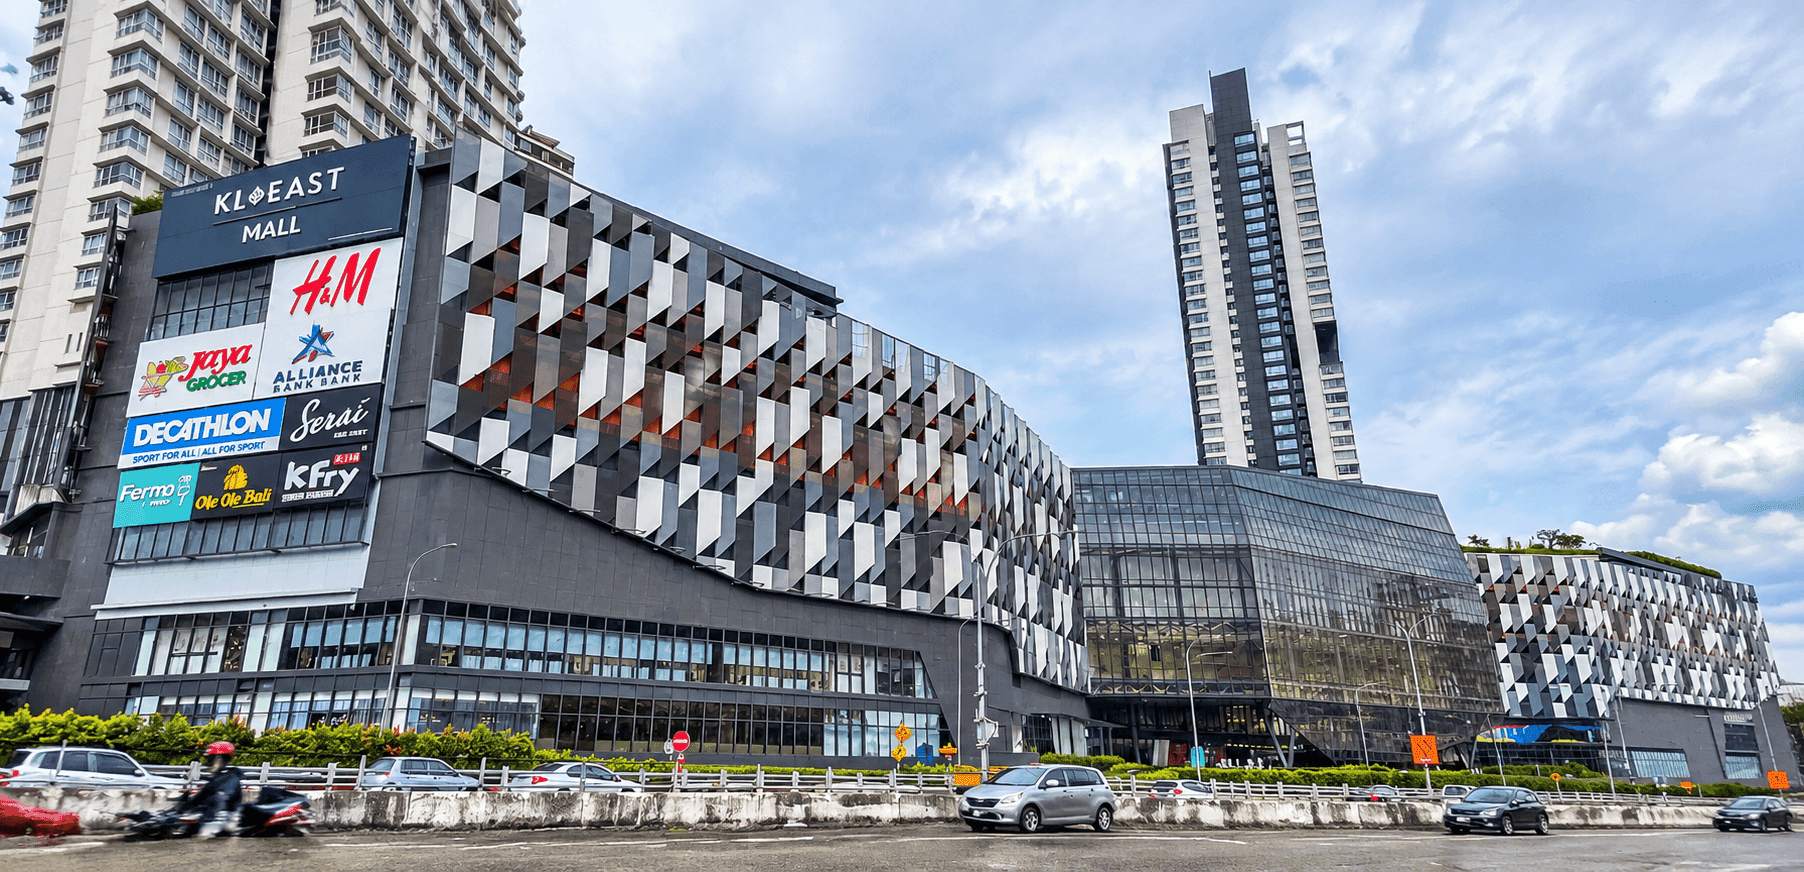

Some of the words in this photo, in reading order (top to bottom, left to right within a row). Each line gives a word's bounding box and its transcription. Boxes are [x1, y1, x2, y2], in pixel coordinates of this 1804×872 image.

[213, 191, 246, 215] KL
[267, 166, 345, 203] EAST
[241, 215, 301, 243] MALL
[289, 247, 382, 315] H&M
[178, 344, 253, 382] Jaya
[272, 360, 363, 384] ALLIANCE
[186, 370, 247, 392] GROCER
[133, 407, 272, 447] DECATHLON
[132, 453, 161, 464] SPORT
[162, 451, 180, 461] FOR
[180, 448, 196, 458] ALL
[201, 445, 217, 455] ALL
[218, 443, 236, 453] FOR
[237, 441, 266, 451] SPORT
[119, 484, 175, 502] Fermo
[195, 495, 219, 510] Ole
[220, 491, 241, 508] Ole
[242, 488, 273, 504] Bali
